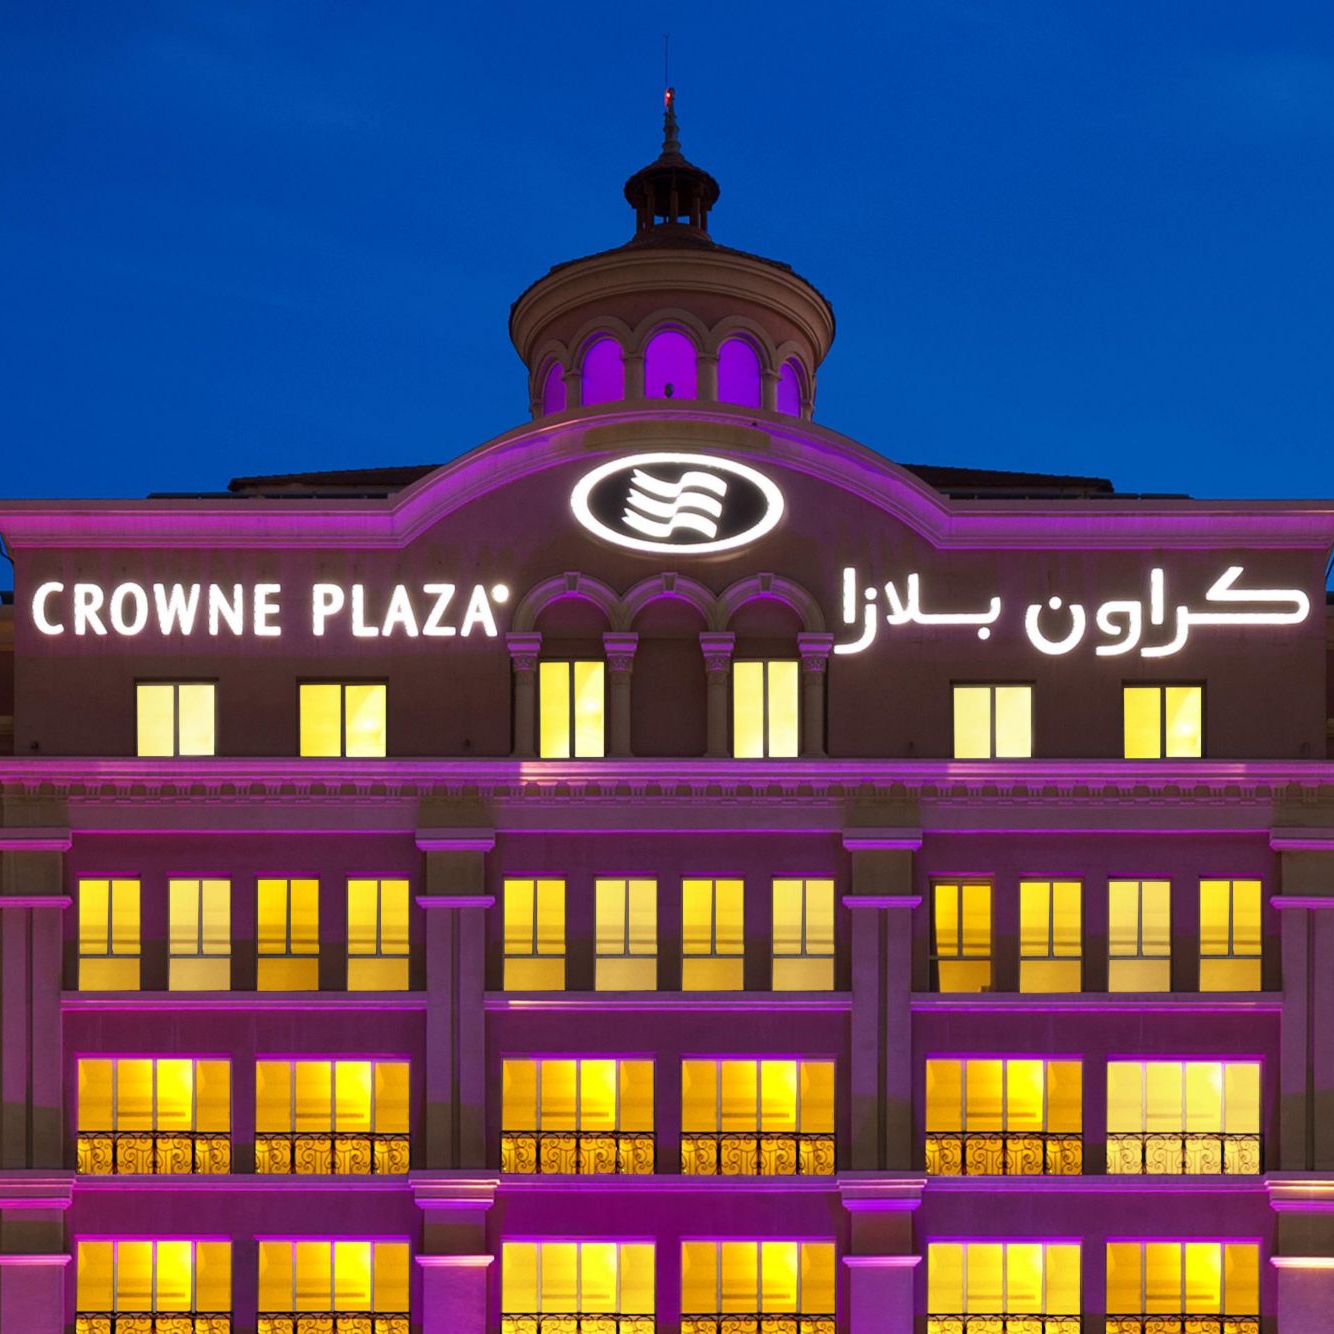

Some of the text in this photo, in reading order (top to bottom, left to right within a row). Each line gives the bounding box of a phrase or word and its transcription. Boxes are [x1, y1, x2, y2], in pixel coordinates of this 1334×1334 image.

[31, 580, 283, 637] CROWNE
[832, 565, 1311, 659] كراون بلازا
